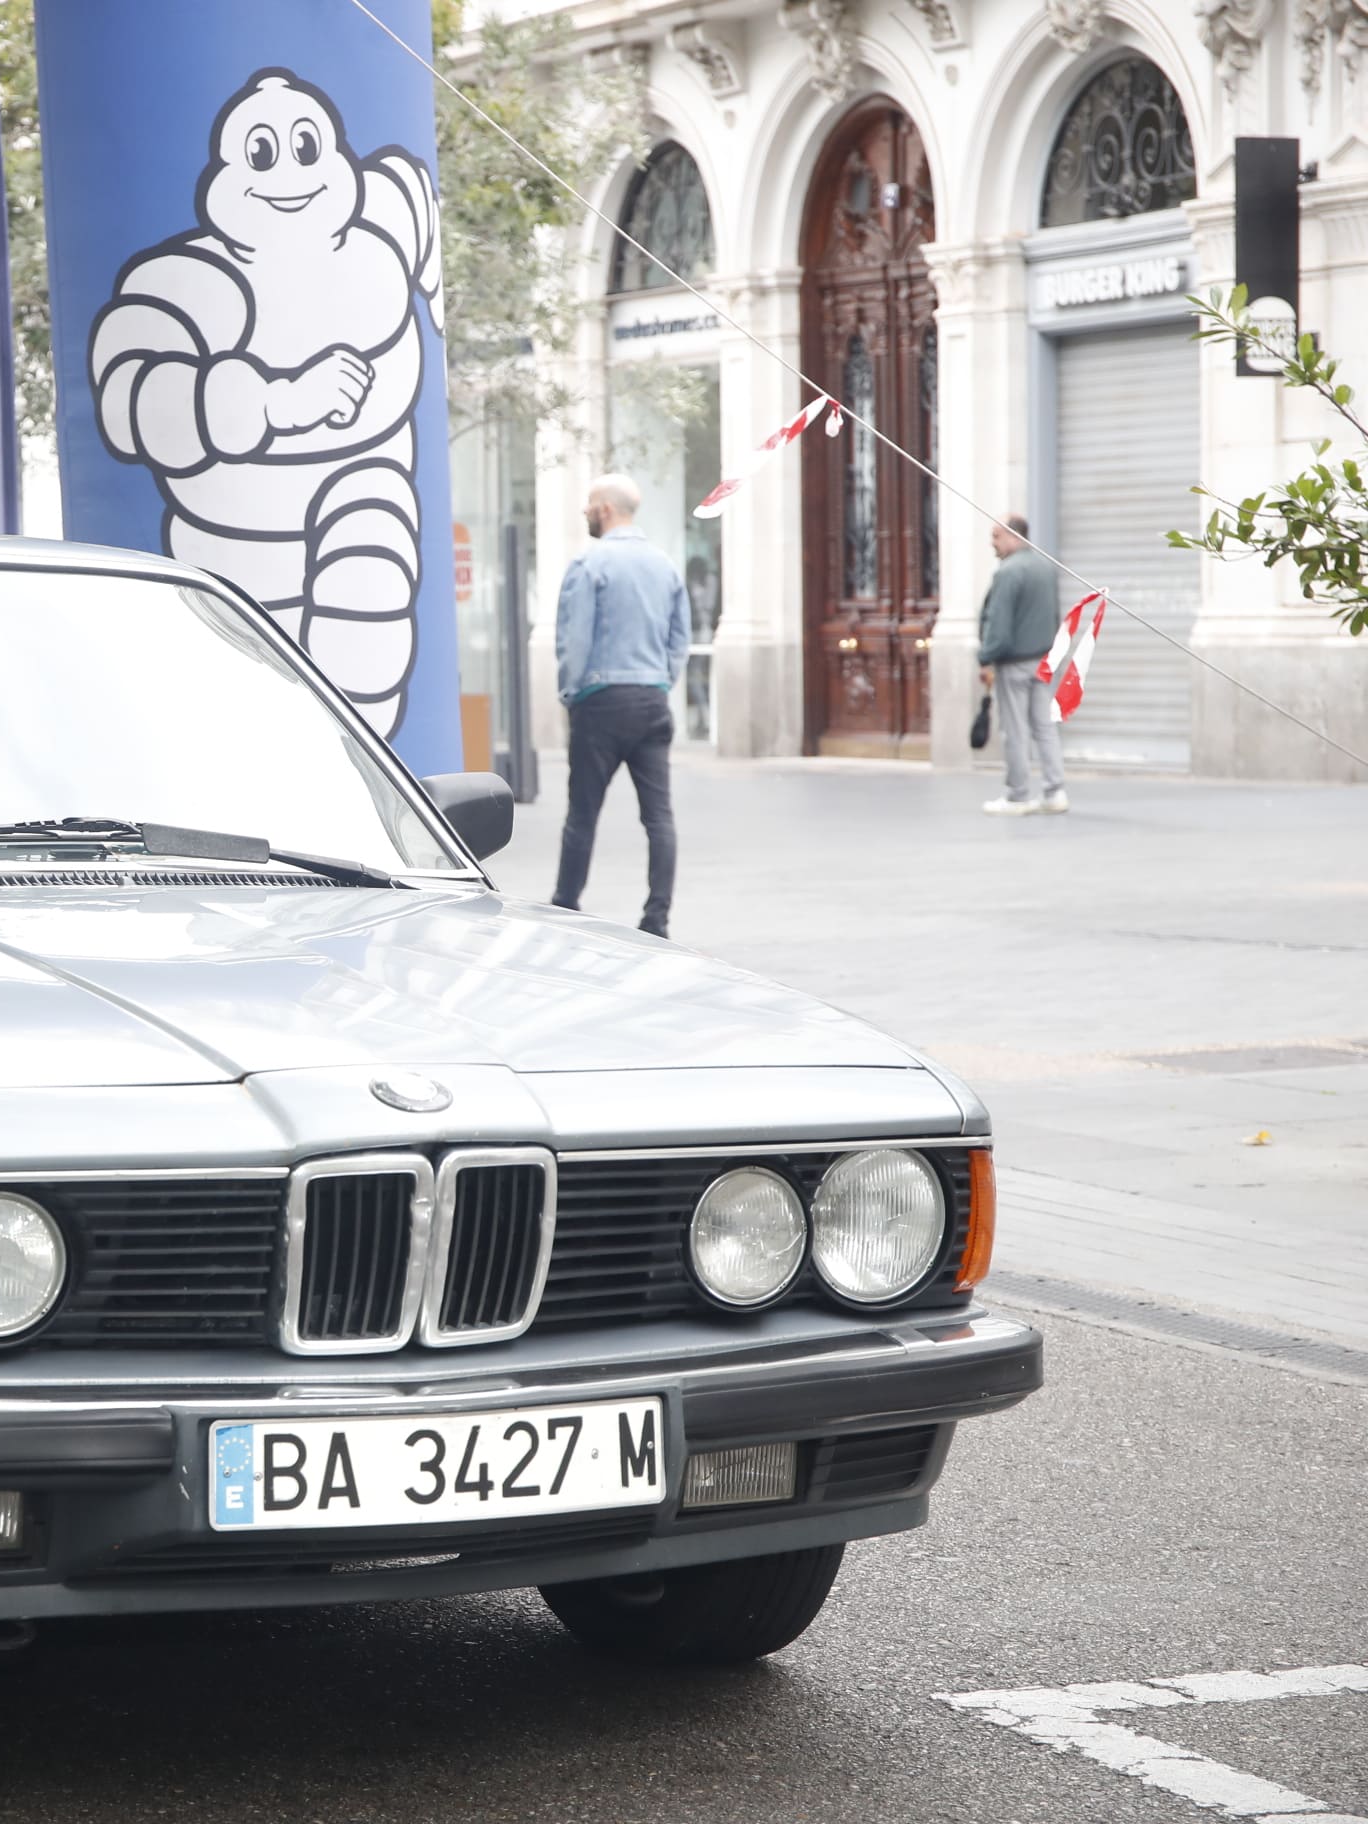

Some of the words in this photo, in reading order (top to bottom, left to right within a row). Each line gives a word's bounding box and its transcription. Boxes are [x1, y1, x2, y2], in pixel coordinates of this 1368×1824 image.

[1038, 265, 1124, 307] BURGER
[1126, 256, 1180, 297] KING
[263, 1431, 361, 1511] BA
[403, 1416, 584, 1506] 3427
[618, 1409, 657, 1488] M
[225, 1485, 244, 1509] E
